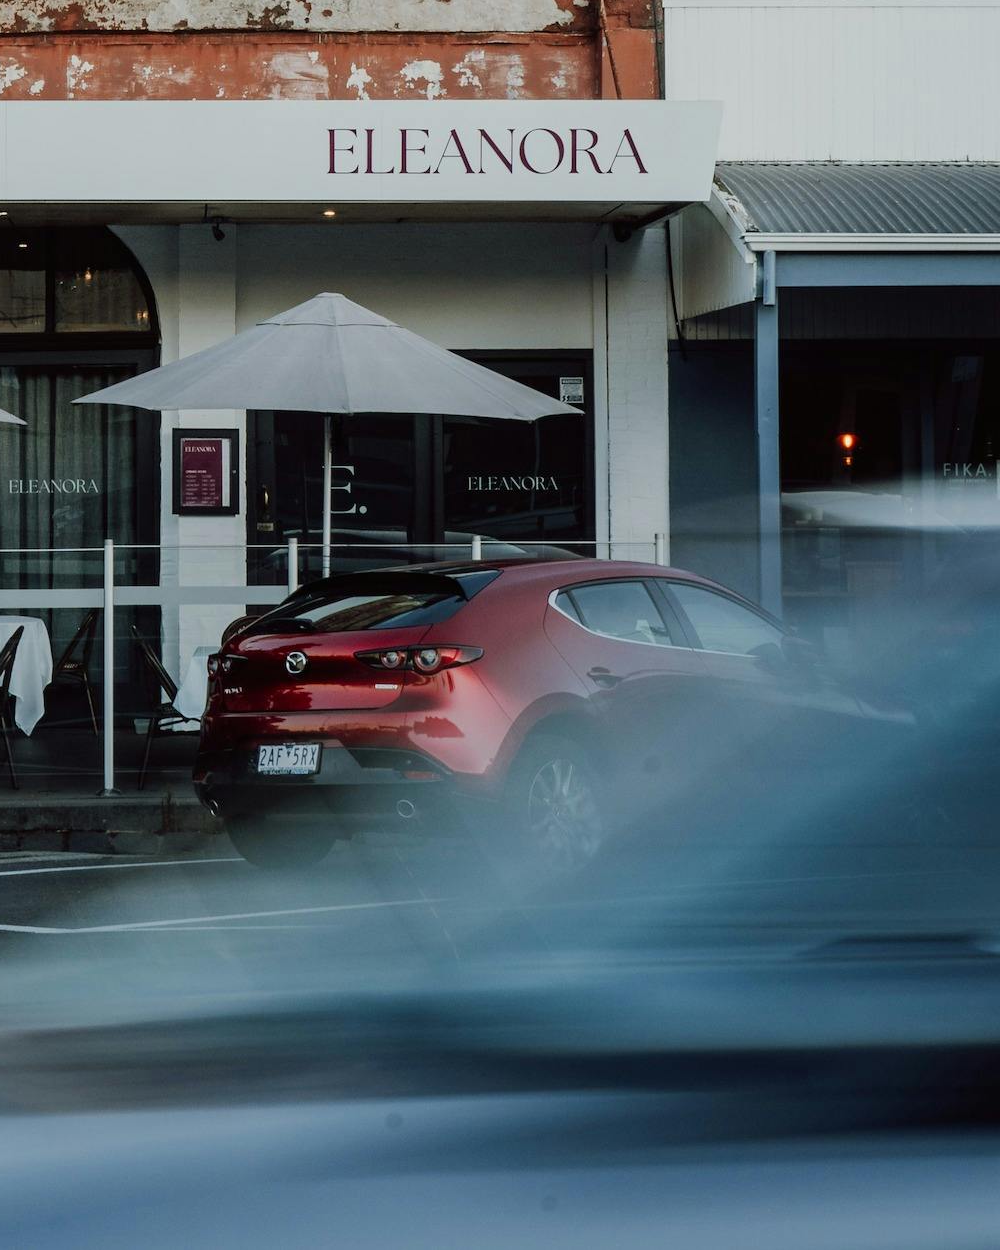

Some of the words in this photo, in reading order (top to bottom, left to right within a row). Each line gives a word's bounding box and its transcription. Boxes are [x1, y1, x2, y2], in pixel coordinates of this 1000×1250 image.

[326, 127, 650, 175] ELEANORA
[943, 462, 992, 477] FIKA.
[8, 478, 100, 495] ELEANORA
[467, 476, 559, 491] ELEANORA
[260, 747, 283, 766] 2AF
